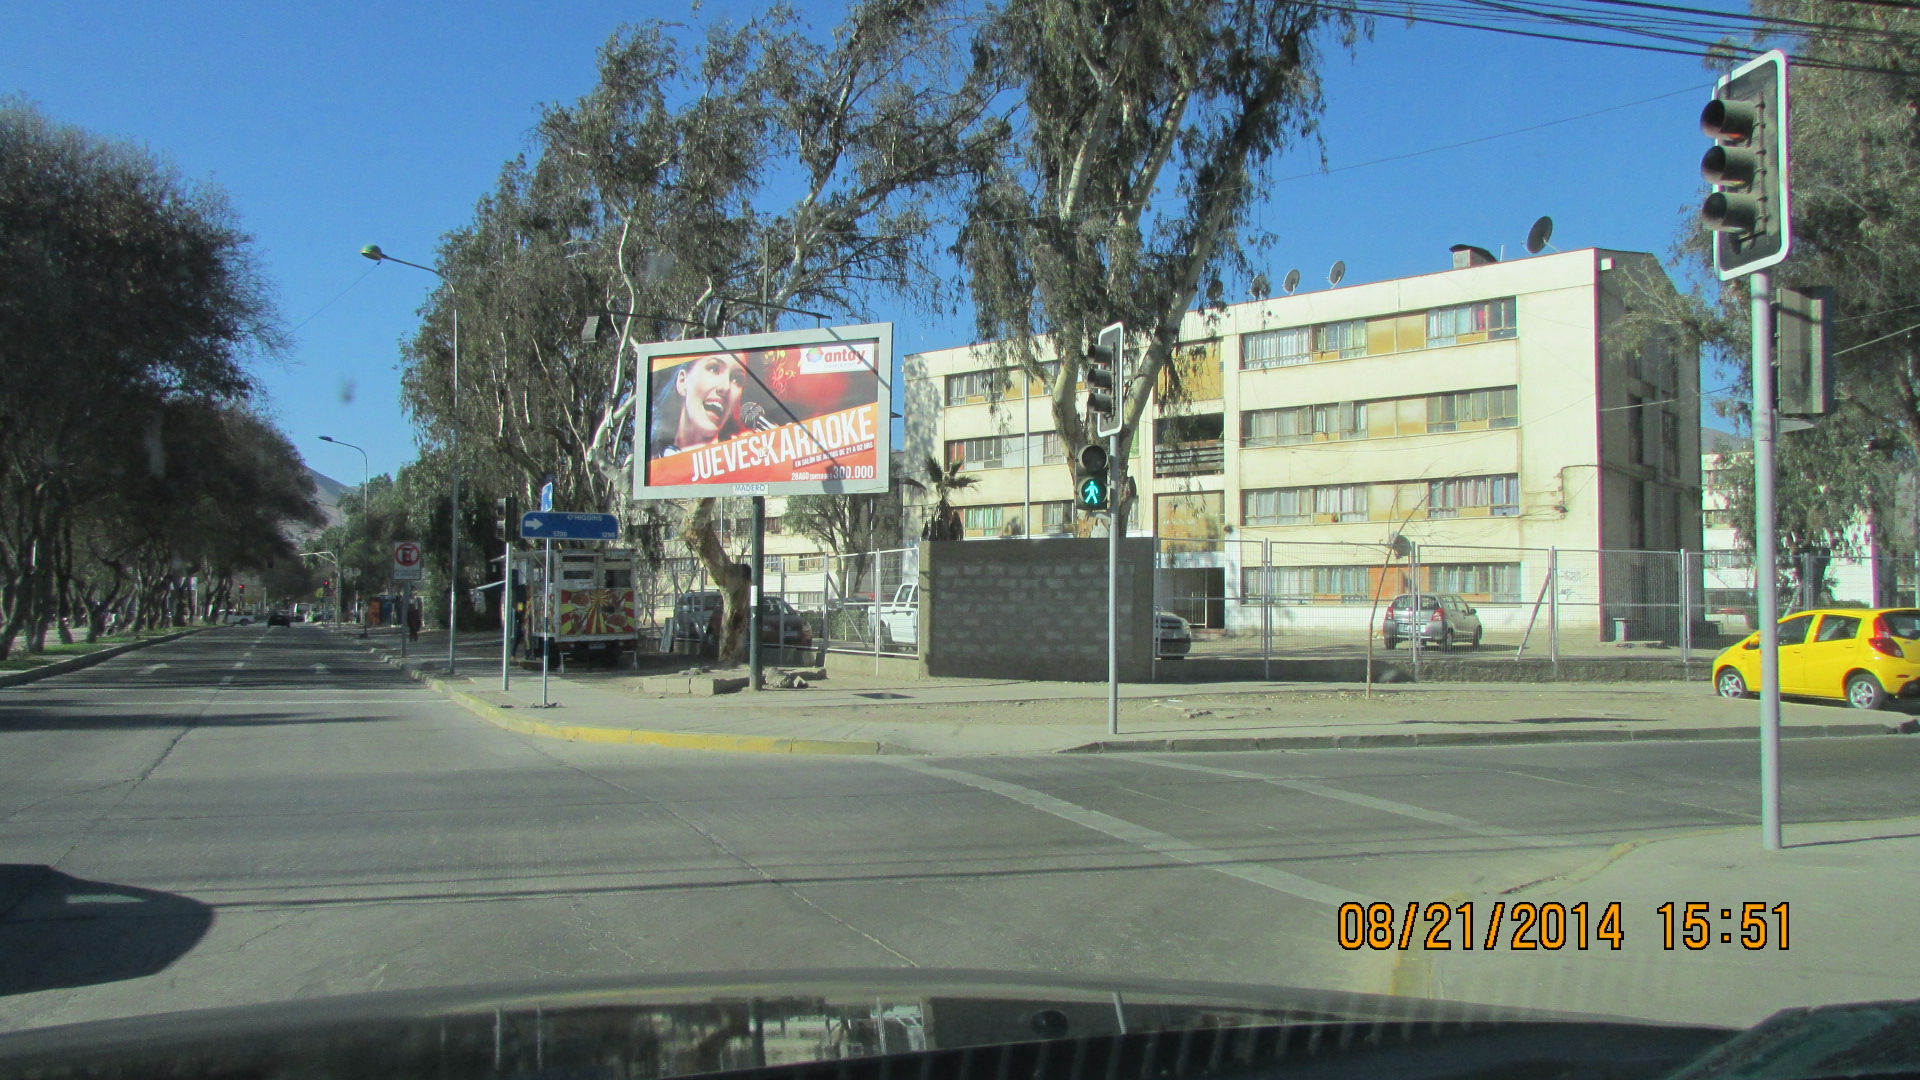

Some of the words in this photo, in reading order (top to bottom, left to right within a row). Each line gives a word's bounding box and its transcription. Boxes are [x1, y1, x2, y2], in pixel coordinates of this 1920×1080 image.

[824, 348, 866, 364] antay
[692, 435, 761, 481] JUEVES
[763, 406, 875, 466] KARAOKE
